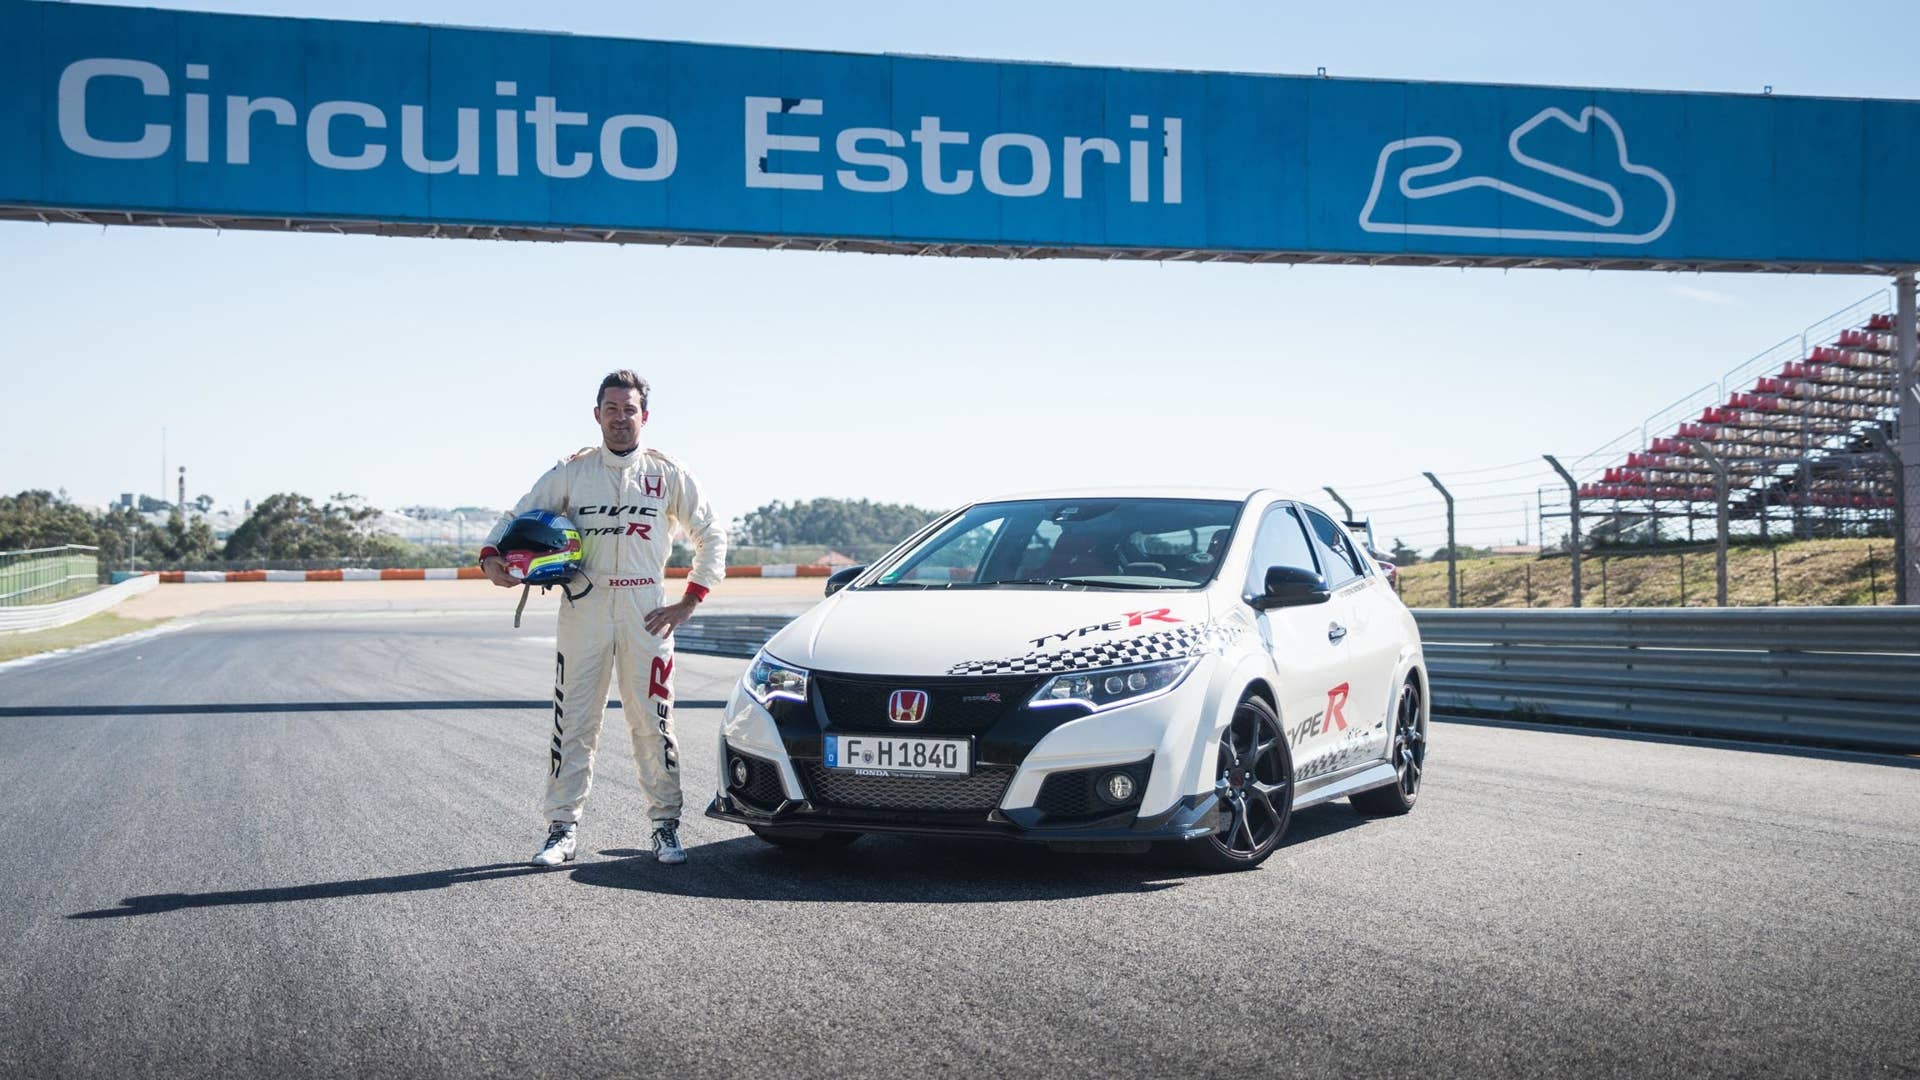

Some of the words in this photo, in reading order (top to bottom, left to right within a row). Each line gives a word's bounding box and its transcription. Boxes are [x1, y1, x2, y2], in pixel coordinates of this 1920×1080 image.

[58, 57, 678, 182] Circuito
[745, 96, 1182, 203] Estoril
[578, 505, 658, 517] CIVIC
[608, 577, 656, 587] HONDA
[550, 651, 565, 779] CIVIC
[855, 768, 890, 777] HONDA
